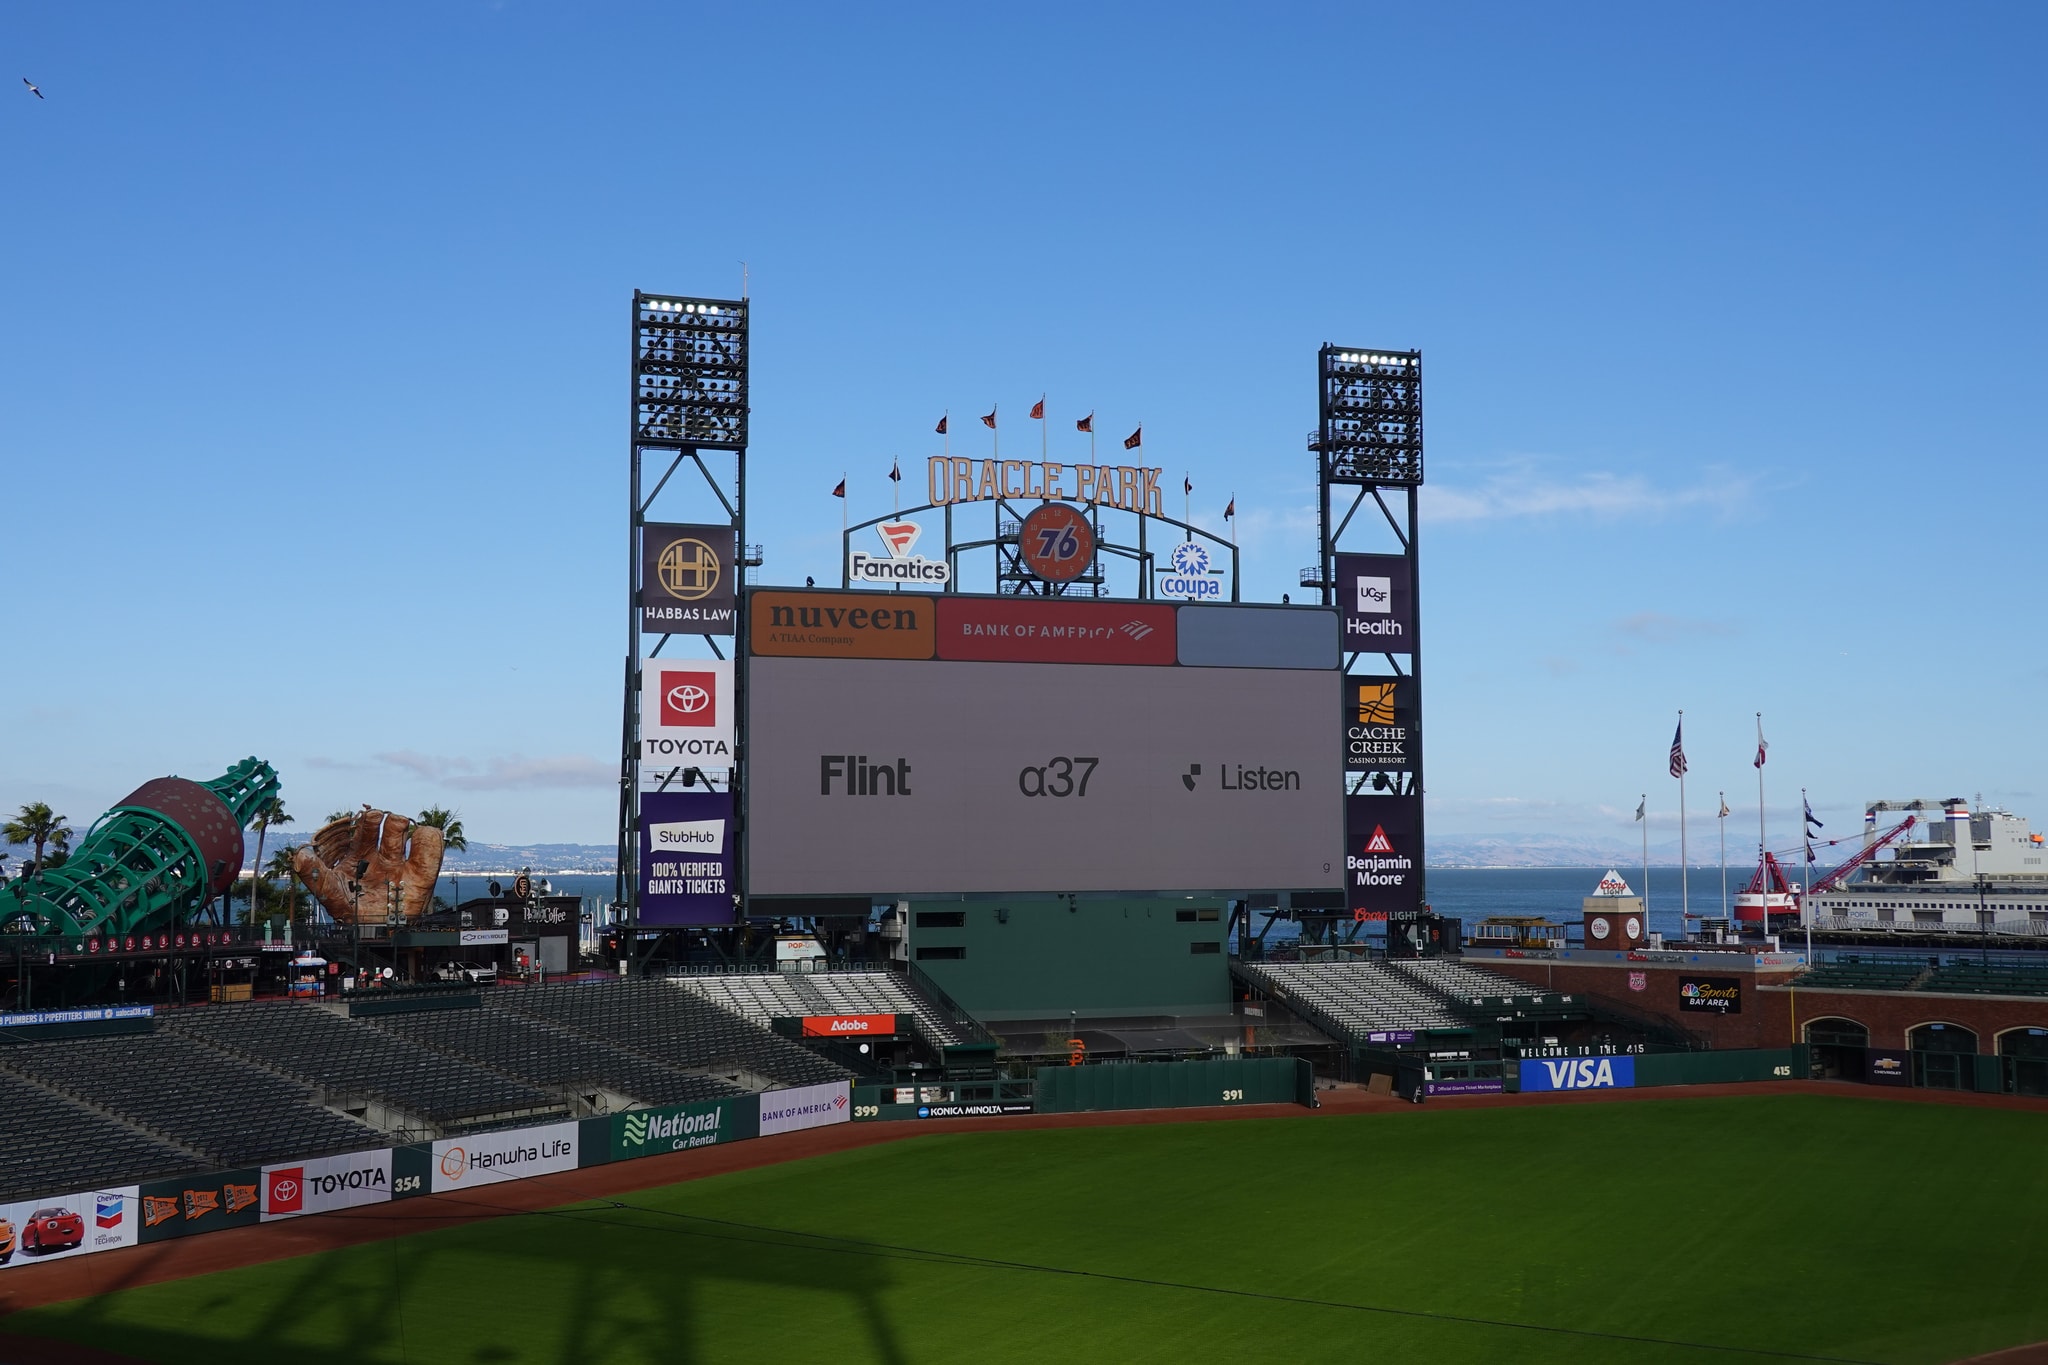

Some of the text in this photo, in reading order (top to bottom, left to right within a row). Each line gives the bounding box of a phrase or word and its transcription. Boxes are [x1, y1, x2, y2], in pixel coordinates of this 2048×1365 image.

[929, 456, 1164, 518] ORACLE PARK
[1036, 525, 1080, 562] 76
[853, 555, 946, 580] Fanatics
[1165, 578, 1220, 600] coupa
[1361, 587, 1387, 602] UCSF
[646, 607, 731, 620] HABBAS LAW
[770, 604, 918, 631] nuveen
[963, 623, 1009, 637] BANK
[1014, 624, 1036, 637] OF
[1347, 618, 1402, 635] Health
[769, 633, 855, 646] A TIAA Company
[1348, 727, 1406, 740] CACHE
[646, 739, 729, 755] TOYOTA
[1350, 741, 1404, 754] CREEK
[820, 755, 912, 796] Flint
[1220, 764, 1301, 790] Listen
[659, 831, 715, 843] StubHub
[651, 862, 723, 877] 100% VERIFIED
[1347, 855, 1412, 873] Benjamin
[648, 879, 726, 895] GIANTS TICKETS
[1599, 879, 1626, 890] Coors
[544, 906, 567, 925] Coffee
[1354, 908, 1418, 922] Coors LIGHT
[477, 933, 508, 941] CHEVROLET
[1698, 983, 1739, 999] Sports
[1689, 998, 1729, 1007] BAY AREA
[4, 1013, 38, 1025] PLUMBERS
[38, 1013, 44, 1023] &
[45, 1010, 83, 1022] PIPEFITTERS
[83, 1009, 102, 1020] UNION
[831, 1020, 868, 1031] Adobe
[1520, 1043, 1645, 1058] WELCOME TO THE 415
[1541, 1058, 1615, 1089] VISA
[1773, 1065, 1791, 1076] 415
[1222, 1089, 1243, 1101] 391
[762, 1102, 832, 1122] BANK OF AMERICA
[854, 1105, 879, 1117] 399
[930, 1106, 963, 1117] KONICA
[964, 1104, 1002, 1115] MINOLTA
[647, 1106, 721, 1141] National
[672, 1131, 717, 1150] Car Rental
[470, 1139, 571, 1170] Hanwha Life
[310, 1167, 386, 1196] TOYOTA
[394, 1175, 421, 1193] 354
[96, 1193, 124, 1203] Chevron
[95, 1234, 123, 1246] TECHRON
